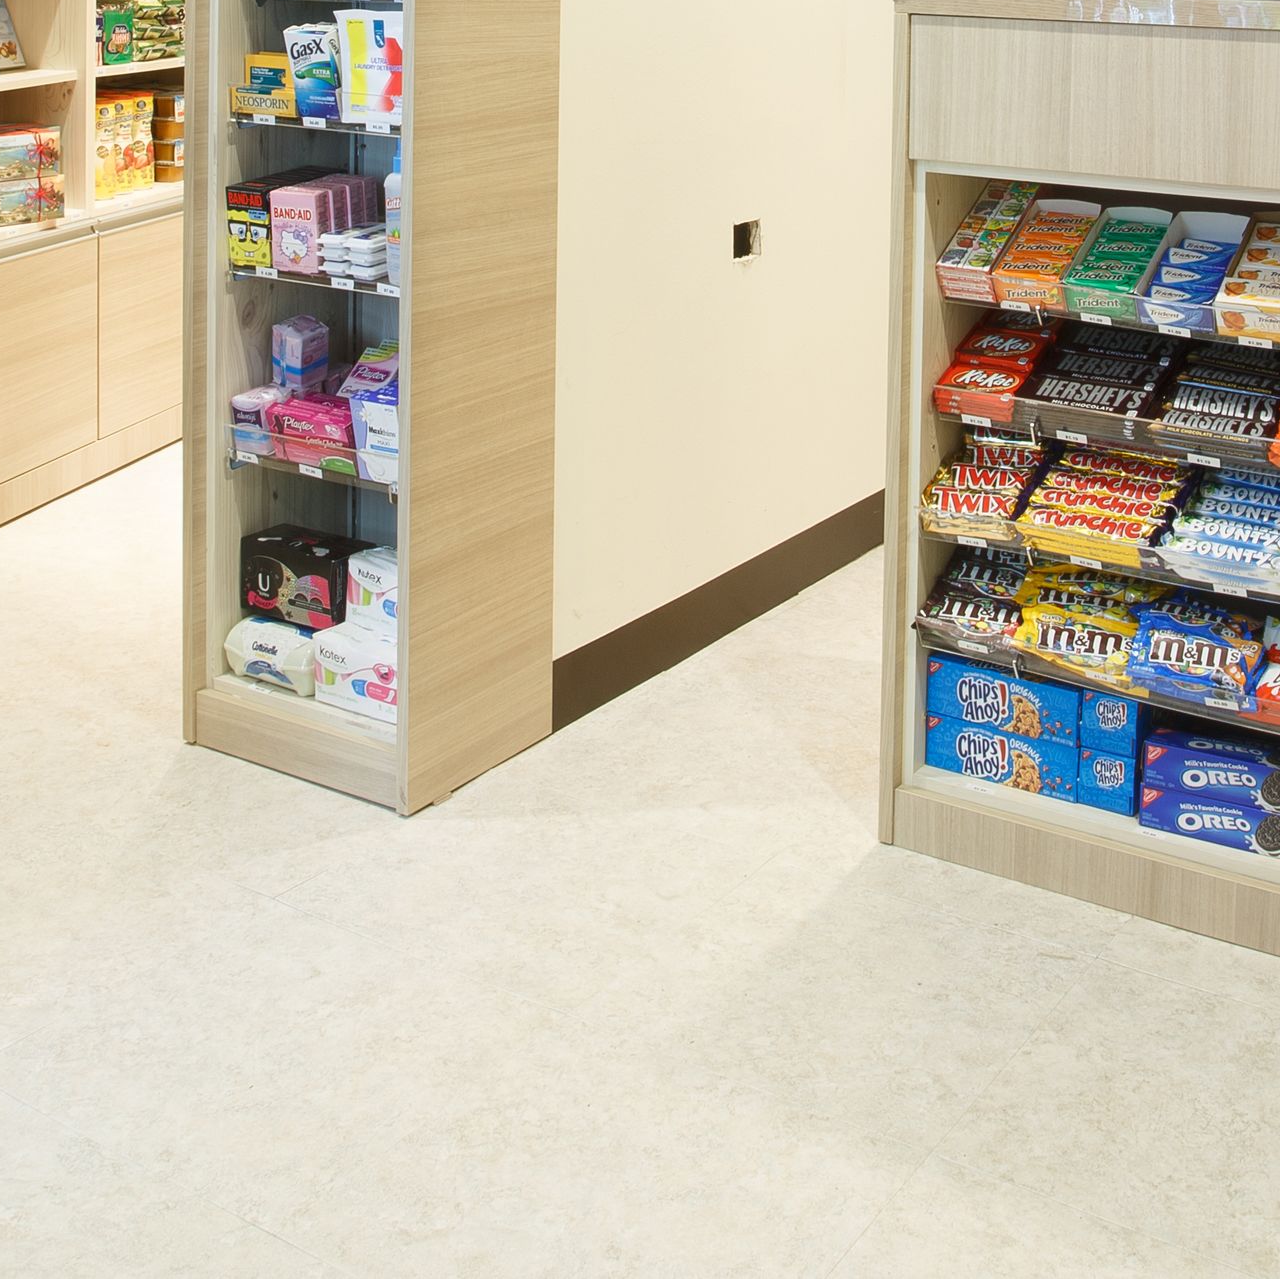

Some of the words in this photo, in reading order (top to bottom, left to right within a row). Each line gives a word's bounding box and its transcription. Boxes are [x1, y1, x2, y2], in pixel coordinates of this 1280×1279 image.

[290, 39, 325, 60] Gas-X
[371, 57, 388, 65] ULTRA
[235, 94, 289, 109] NEOSPORIN
[228, 192, 262, 207] BAND-AID
[274, 207, 311, 221] BAND-AID
[1005, 289, 1048, 298] Trident
[1076, 298, 1120, 308] Trident
[352, 365, 386, 381] Playtex
[1036, 378, 1146, 410] HERSHEY'S
[1070, 401, 1114, 412] CHOCOLATE
[283, 416, 316, 433] Playtex
[1054, 472, 1162, 502] crunchie
[932, 486, 1017, 515] TWIX
[1037, 623, 1133, 655] m&m's
[1150, 636, 1240, 664] m&m's
[958, 677, 998, 703] Chips
[1181, 768, 1258, 790] OREO
[1176, 812, 1252, 834] OREO
